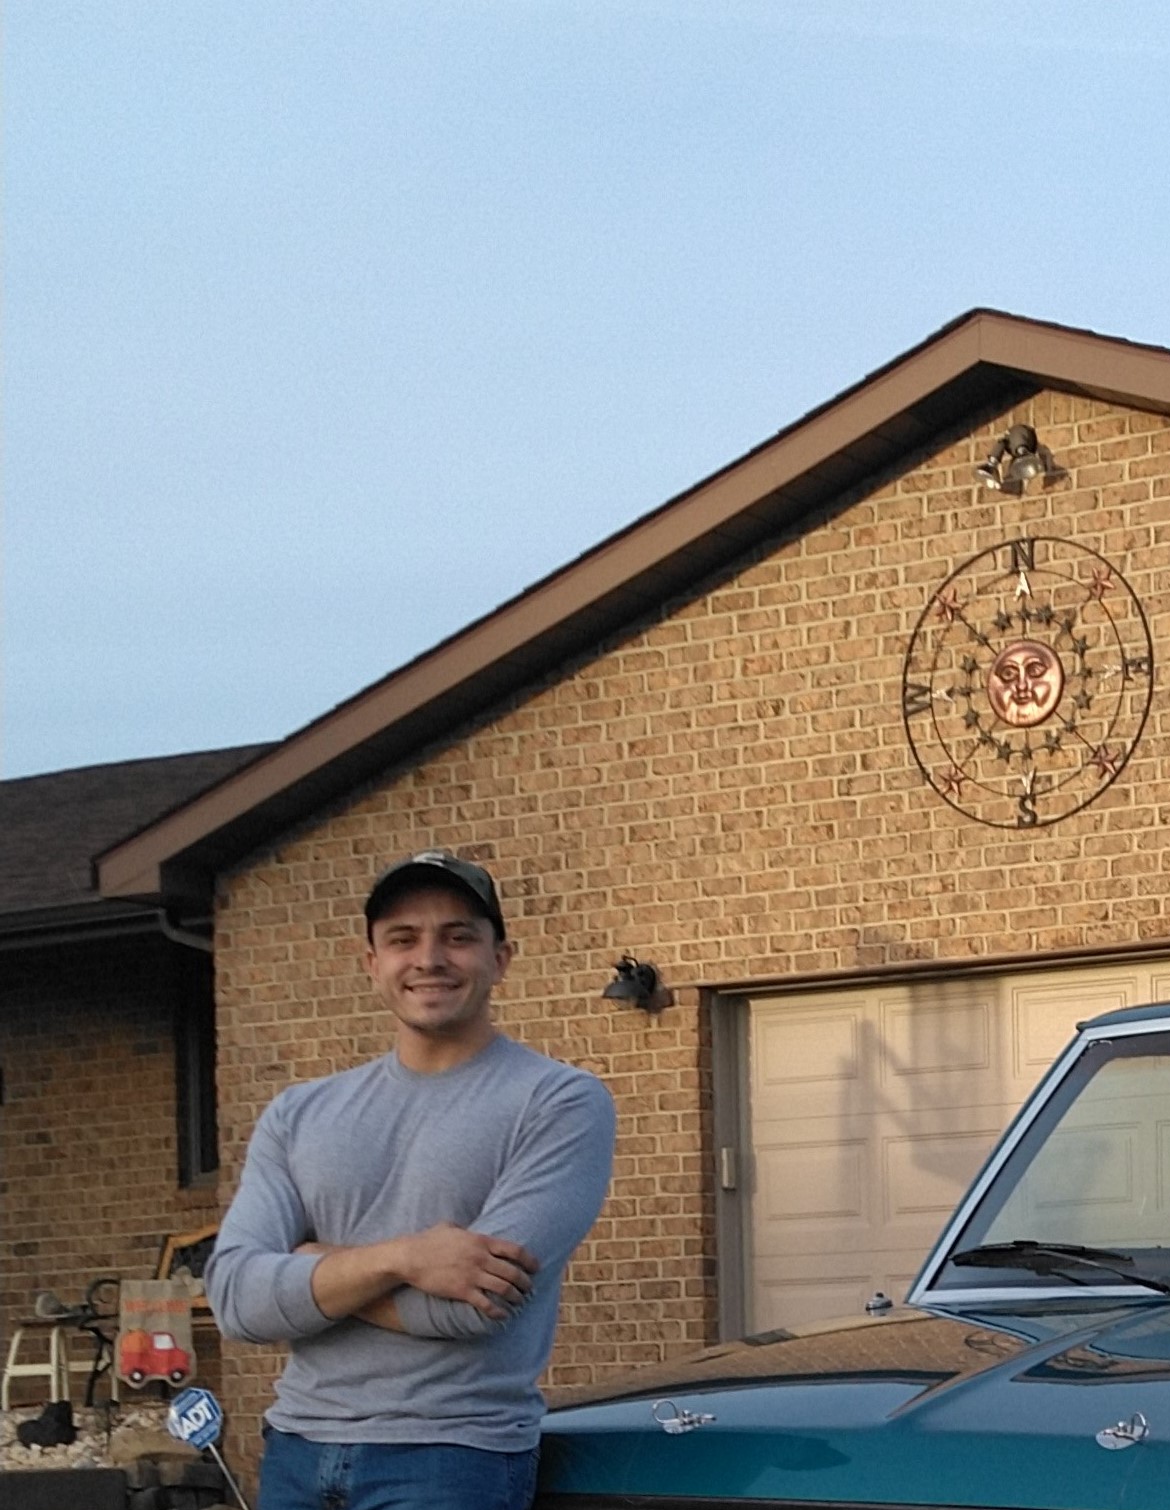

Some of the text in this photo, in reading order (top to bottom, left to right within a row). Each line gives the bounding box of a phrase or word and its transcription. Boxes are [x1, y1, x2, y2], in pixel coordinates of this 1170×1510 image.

[1010, 539, 1035, 572] N
[1017, 794, 1037, 827] S
[180, 1397, 213, 1441] ADT
